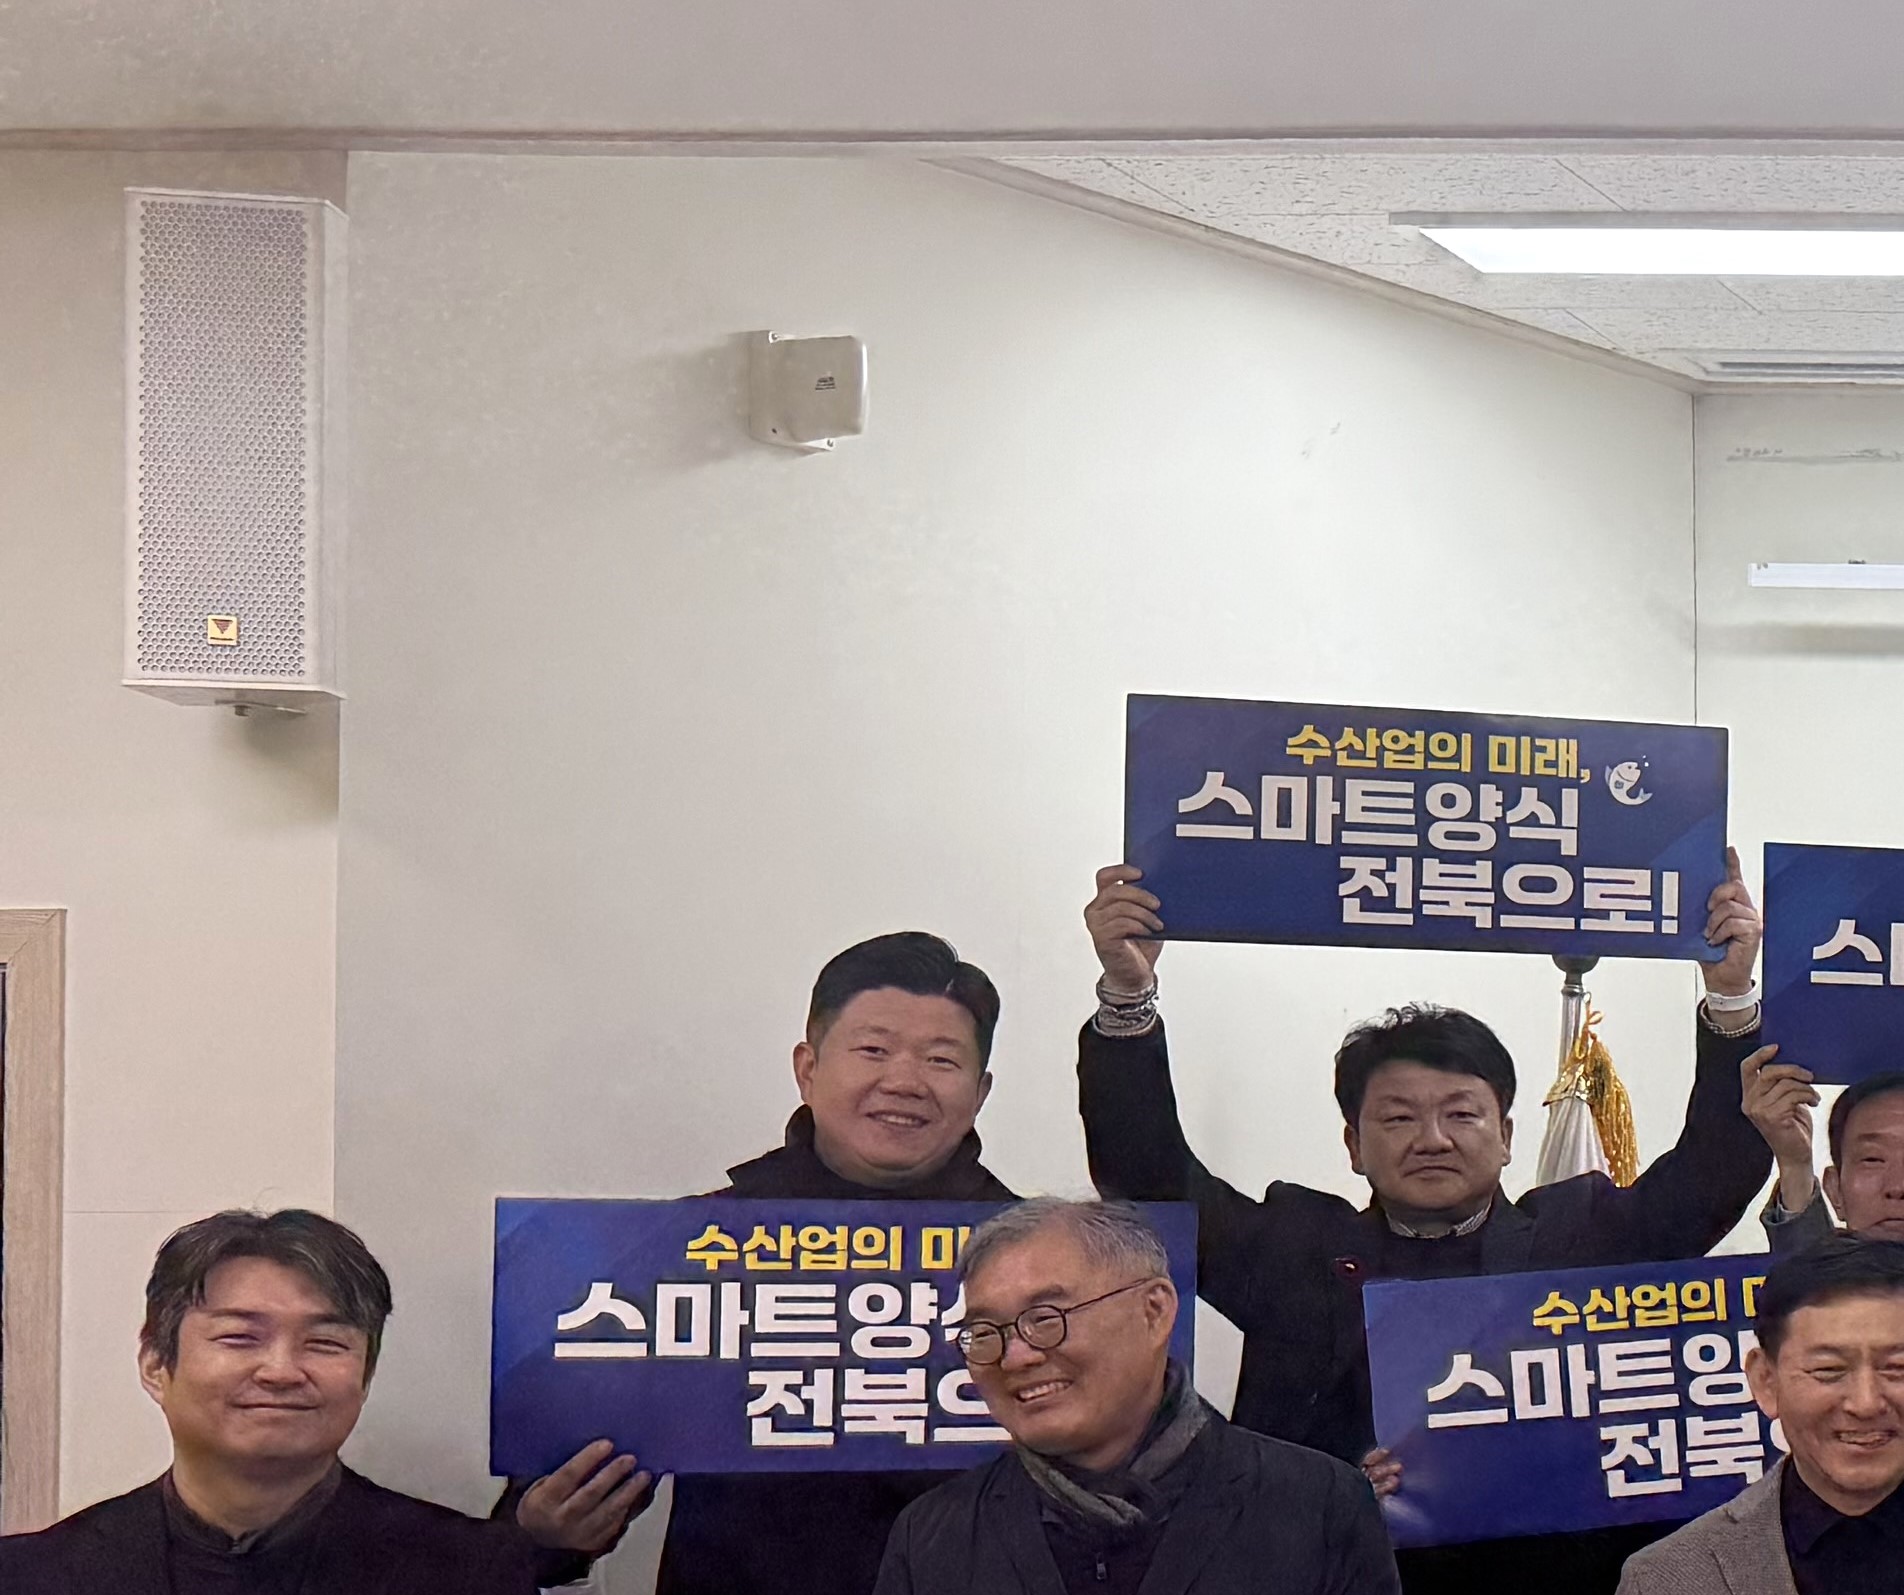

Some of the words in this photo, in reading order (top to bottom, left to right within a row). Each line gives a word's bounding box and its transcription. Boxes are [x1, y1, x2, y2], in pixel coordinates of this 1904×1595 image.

[1286, 725, 1470, 772] 수산업의
[1487, 735, 1590, 783] 미래,
[1176, 772, 1579, 856] 스마트양식
[1339, 856, 1679, 934] 전북으로!
[686, 1225, 901, 1271] 수산업의
[1532, 1278, 1726, 1335] 수산업의
